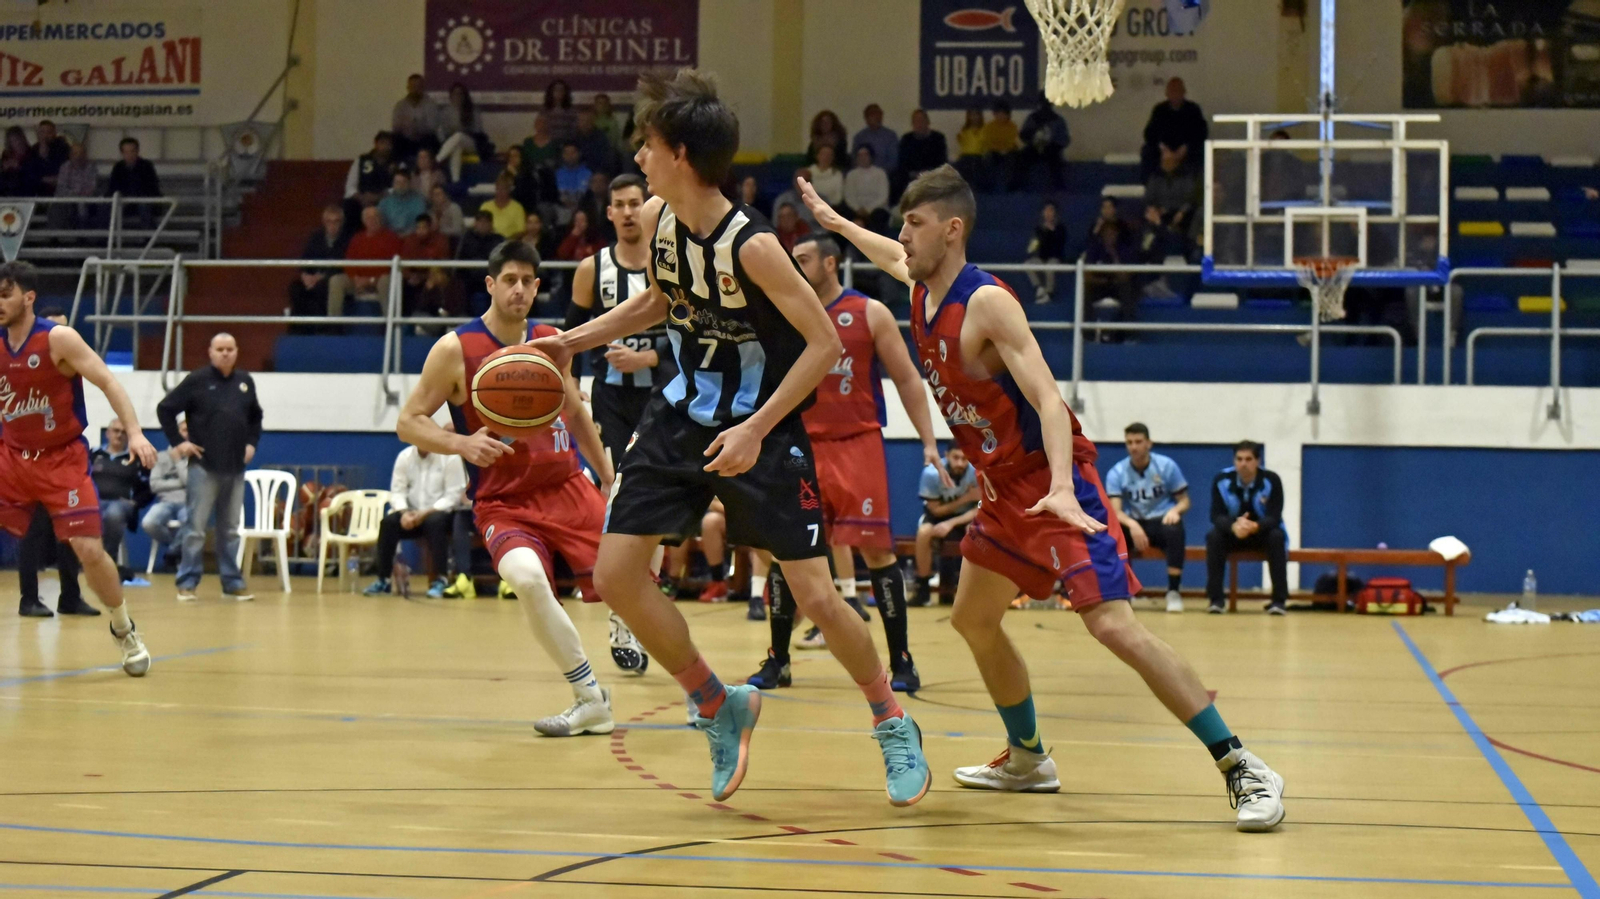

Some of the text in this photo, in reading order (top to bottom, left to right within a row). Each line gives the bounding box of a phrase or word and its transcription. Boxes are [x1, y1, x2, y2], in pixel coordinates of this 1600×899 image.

[541, 14, 652, 36] CLÍNICAS
[503, 37, 691, 62] DR. ESPINEL
[934, 54, 1024, 97] UBAGO
[0, 104, 194, 119] upermercadosruizgalan.es
[698, 337, 719, 369] 7
[495, 369, 549, 384] molten
[839, 376, 852, 395] 6
[552, 429, 571, 454] 10
[981, 428, 998, 454] 8
[68, 489, 80, 508] 5
[861, 497, 873, 516] 6
[806, 523, 819, 547] 7
